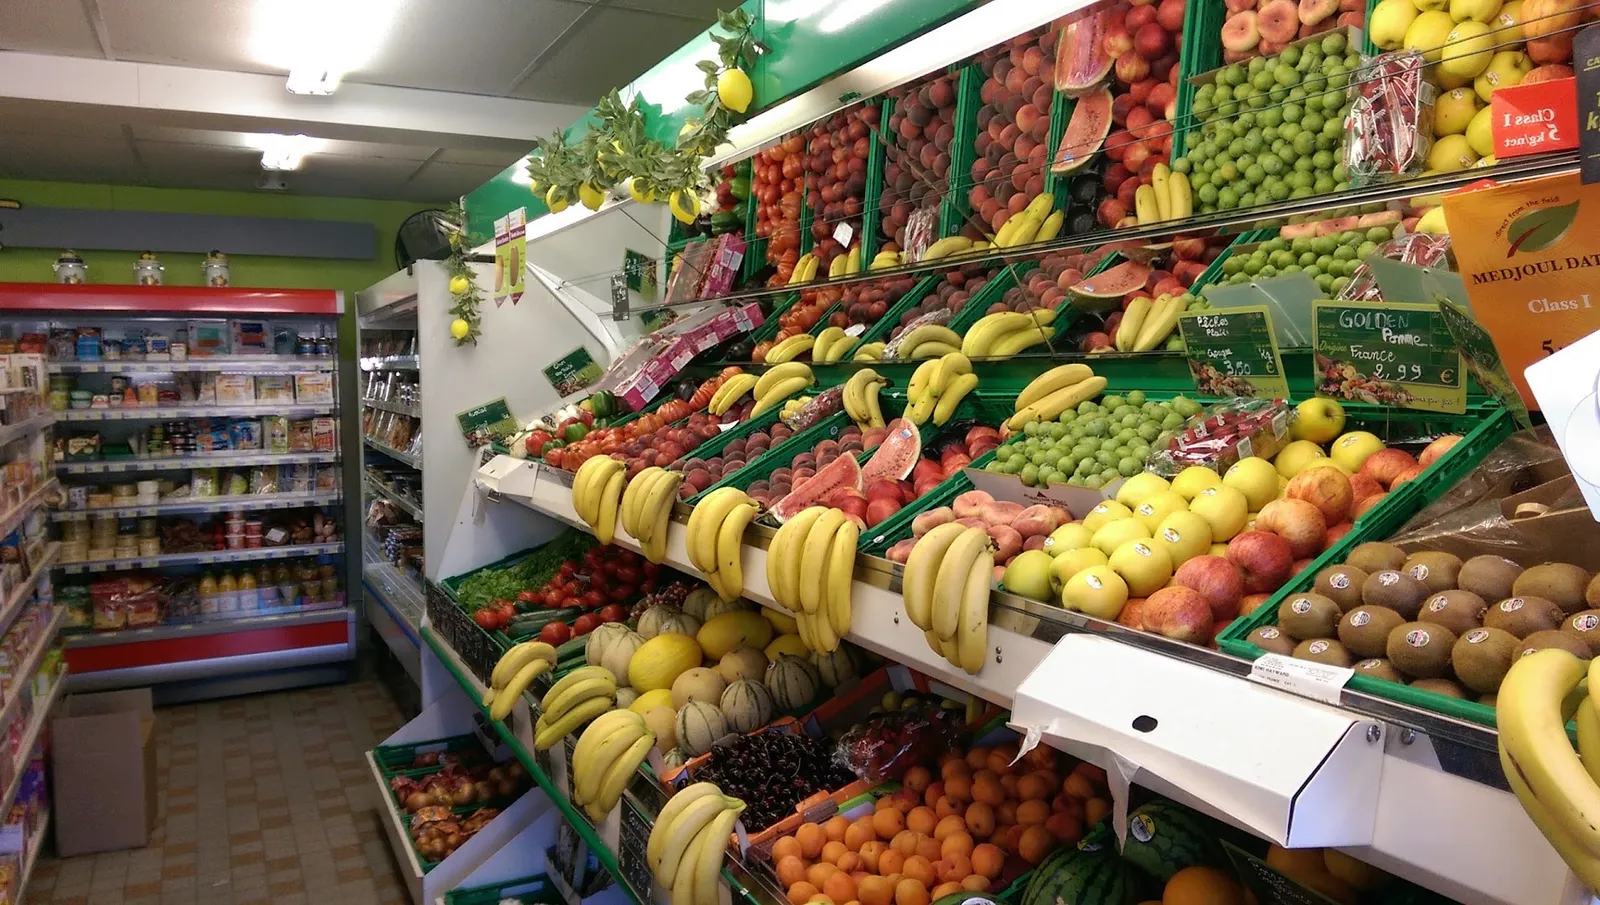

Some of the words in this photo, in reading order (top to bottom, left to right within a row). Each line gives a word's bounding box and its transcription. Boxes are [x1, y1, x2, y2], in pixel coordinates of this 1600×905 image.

[1508, 206, 1524, 219] from
[1526, 199, 1540, 208] the
[1472, 259, 1563, 284] MEDJOUL
[1528, 296, 1579, 314] Class
[1580, 294, 1593, 309] I
[1339, 309, 1410, 330] GOLDEN
[1382, 328, 1429, 347] Pomme
[1319, 340, 1347, 355] Origine
[1350, 345, 1396, 362] France
[1223, 360, 1250, 375] 3,50
[1373, 364, 1421, 381] 2,99
[1440, 369, 1454, 383] €
[1265, 667, 1290, 677] HAYWARD
